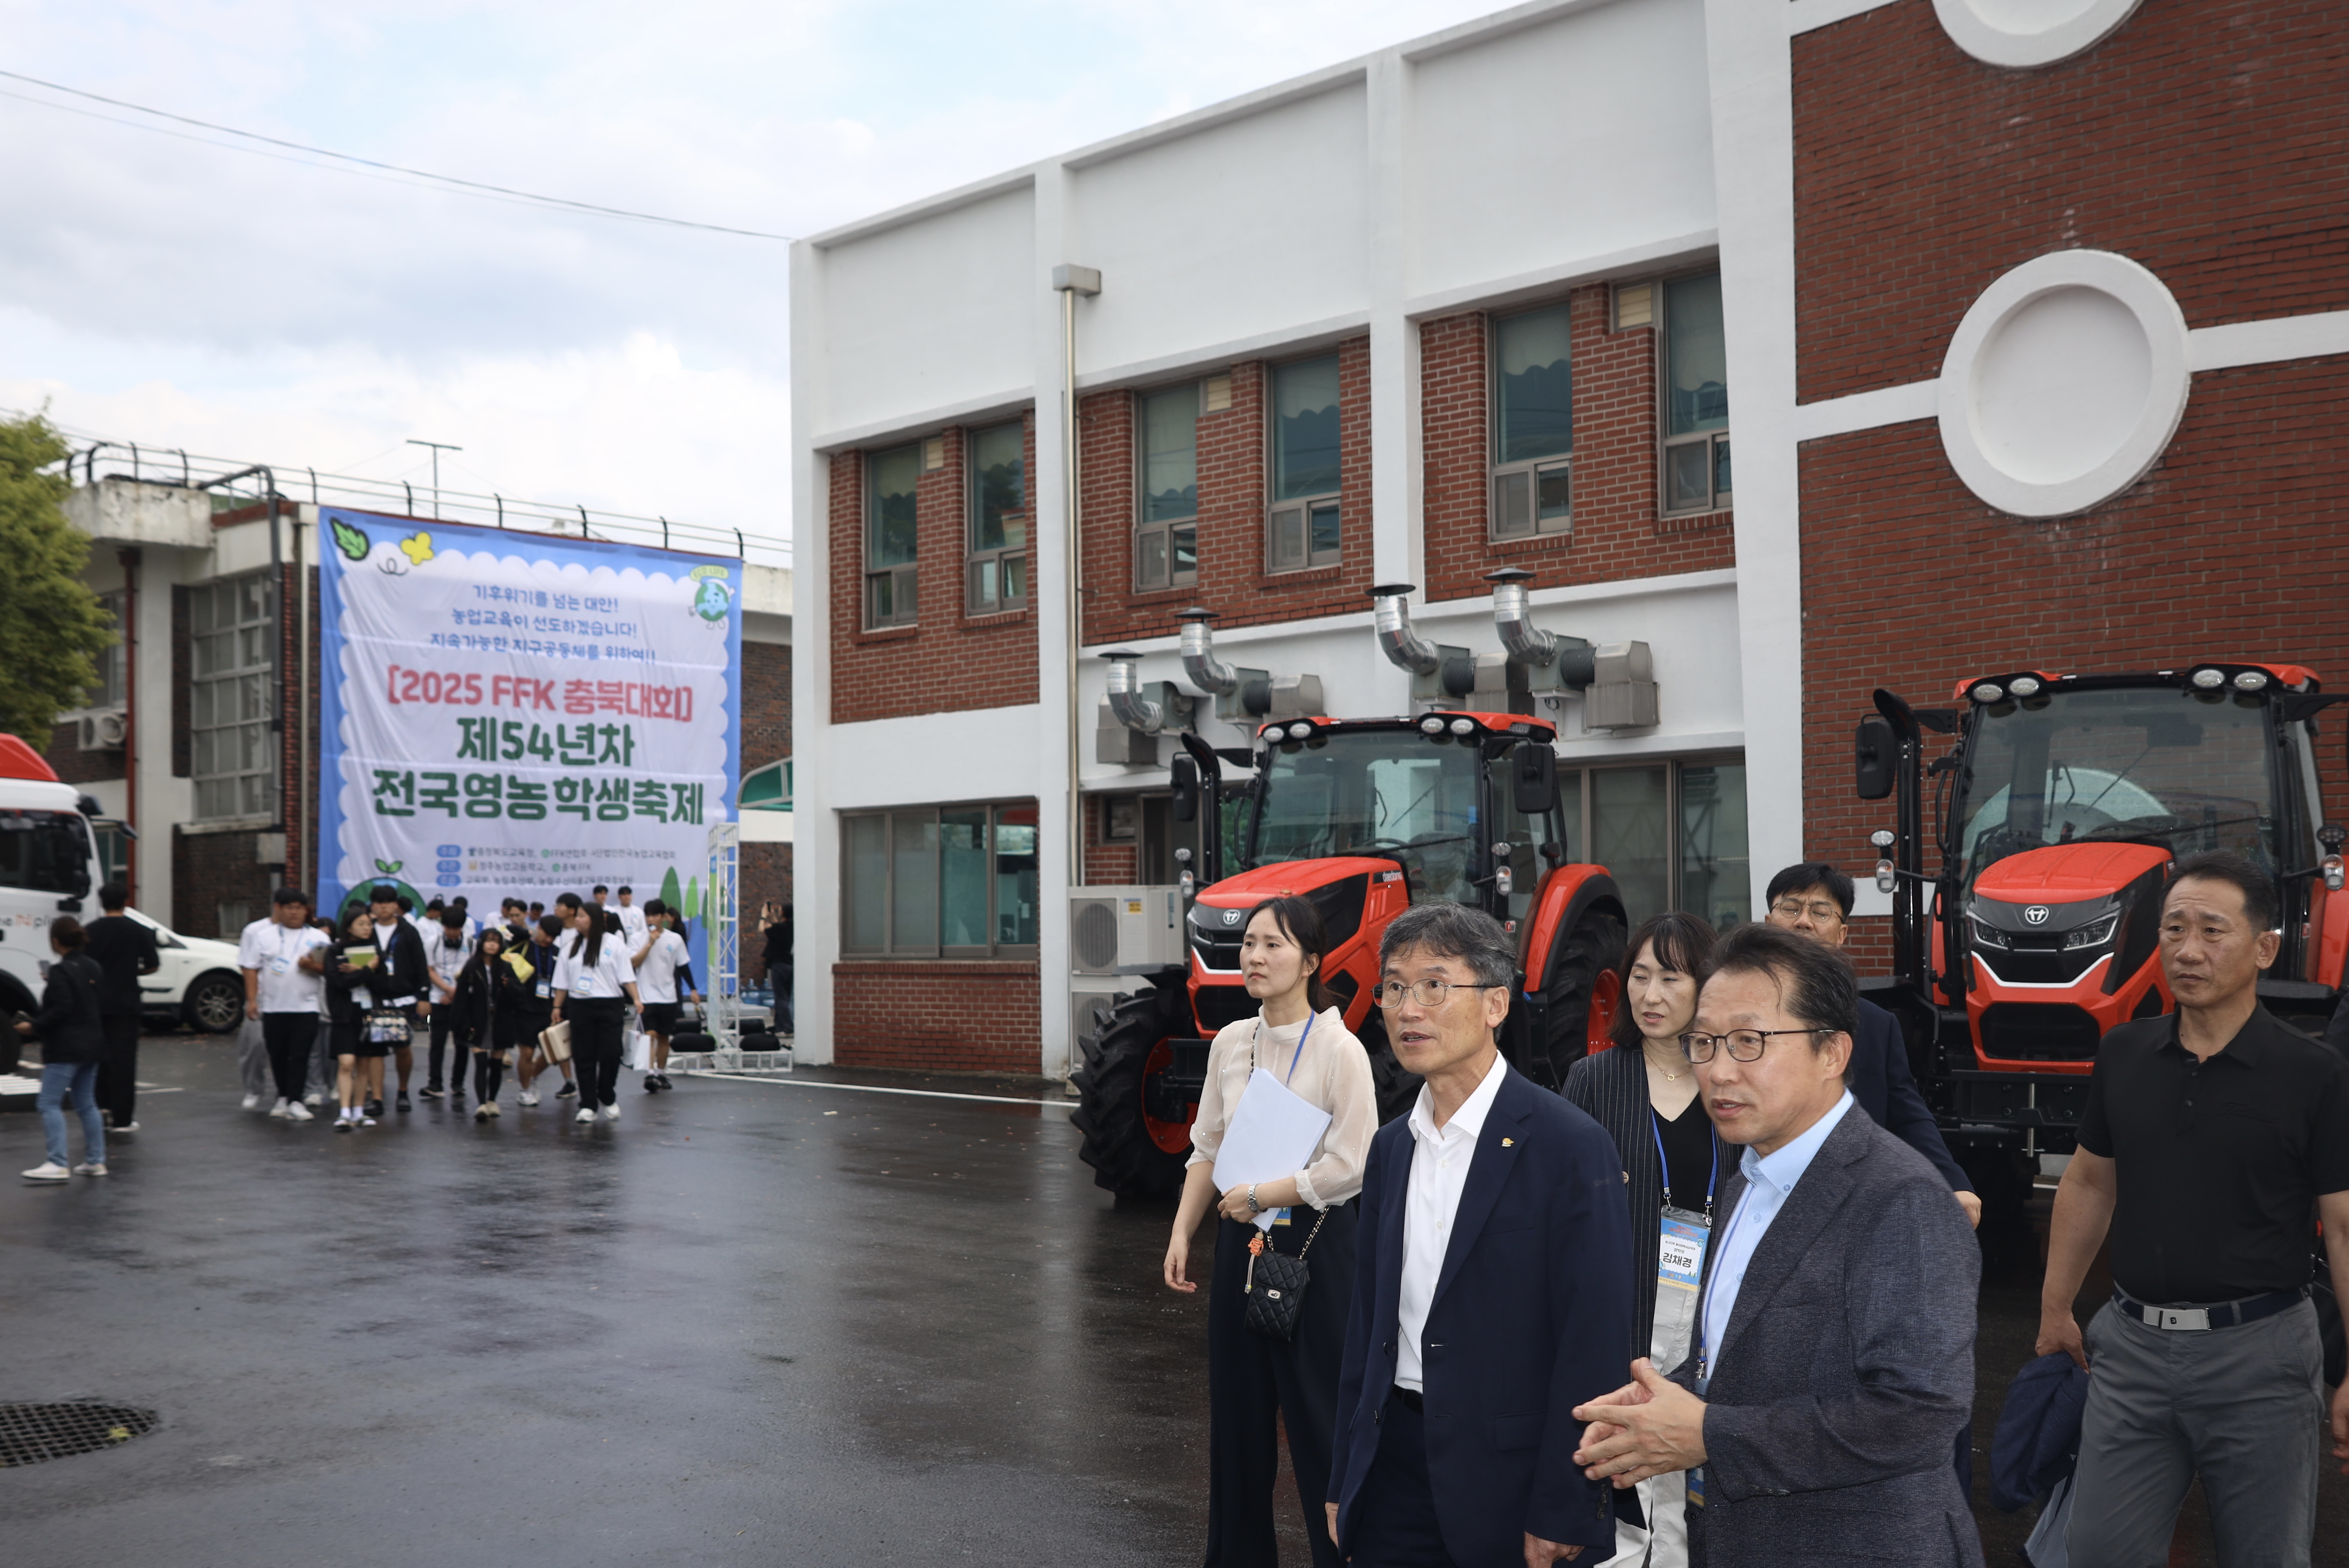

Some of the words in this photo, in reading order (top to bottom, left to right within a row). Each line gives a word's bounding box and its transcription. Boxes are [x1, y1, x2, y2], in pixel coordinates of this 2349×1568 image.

[473, 585, 548, 607] 기후위기를
[553, 593, 580, 611] 넘는
[585, 597, 619, 613] 대안!
[452, 608, 529, 629] 농업교육이
[533, 616, 637, 639] 선도하겠습니다!
[431, 633, 508, 652] 지속가능한
[514, 639, 600, 660] 지구공동체를
[605, 646, 656, 665] 위하여!!
[388, 665, 483, 705] [2025
[492, 675, 556, 711] FFK
[564, 679, 693, 722] 충북대회]
[457, 716, 636, 767] 제54년차
[372, 769, 704, 825] 전국영농학생축제
[1382, 870, 1402, 883] daedong
[1663, 1252, 1692, 1268] 김채경
